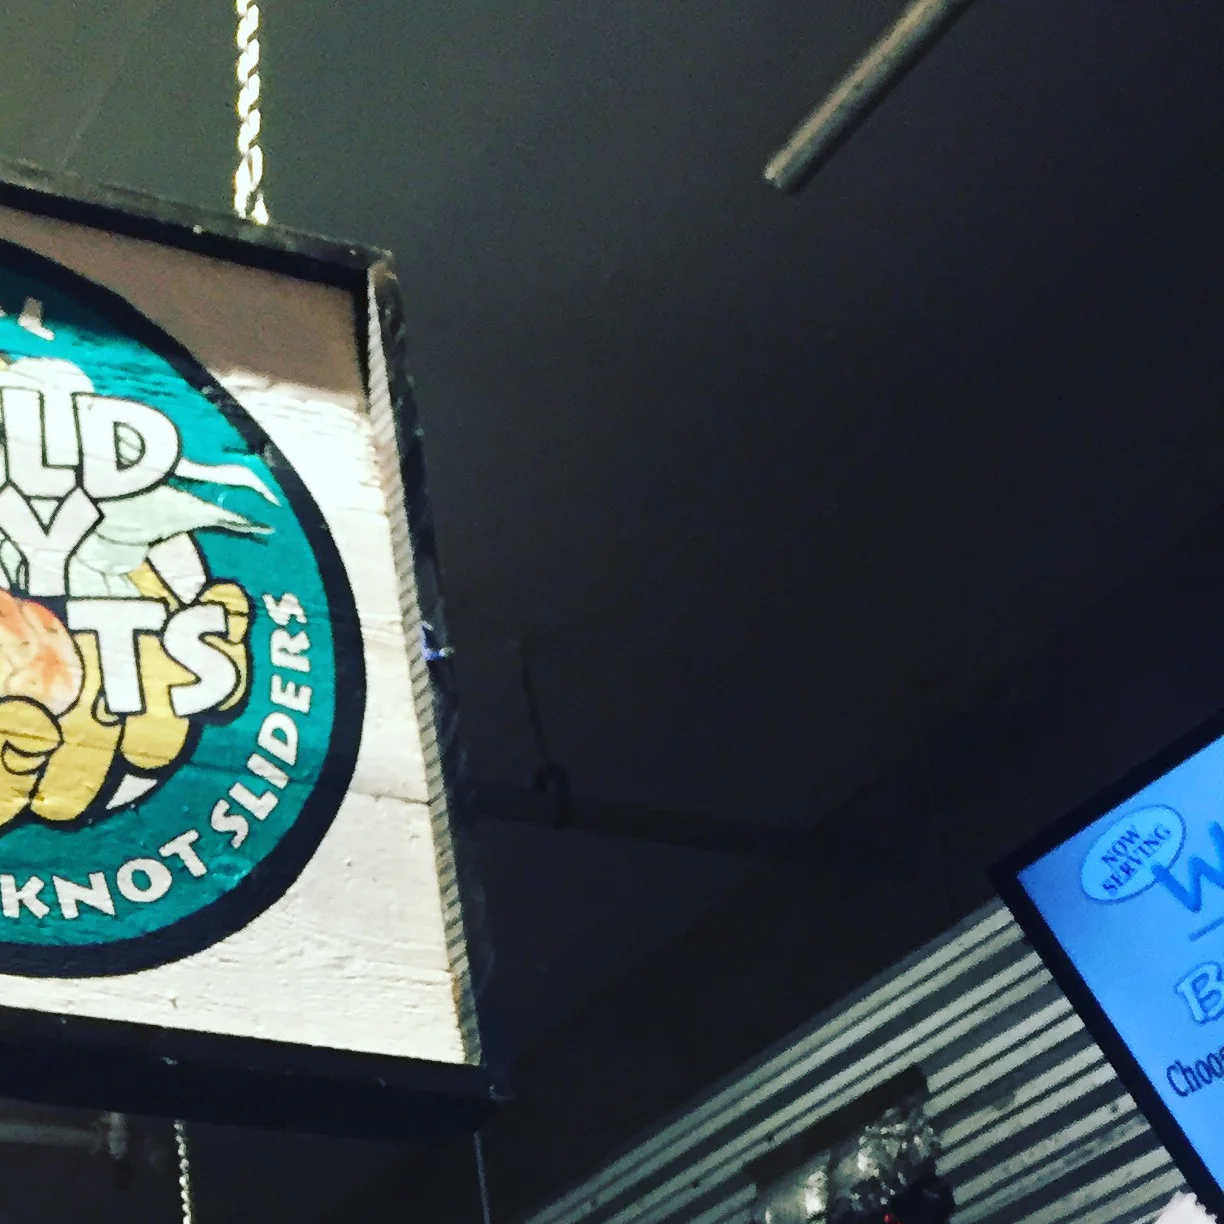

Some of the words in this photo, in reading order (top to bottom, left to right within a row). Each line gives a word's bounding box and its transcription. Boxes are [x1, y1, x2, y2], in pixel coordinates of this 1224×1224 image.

[1, 830, 209, 920] KNOT
[210, 590, 311, 849] SLIDERS
[1101, 824, 1140, 868] NOW
[1101, 822, 1172, 895] SERVING
